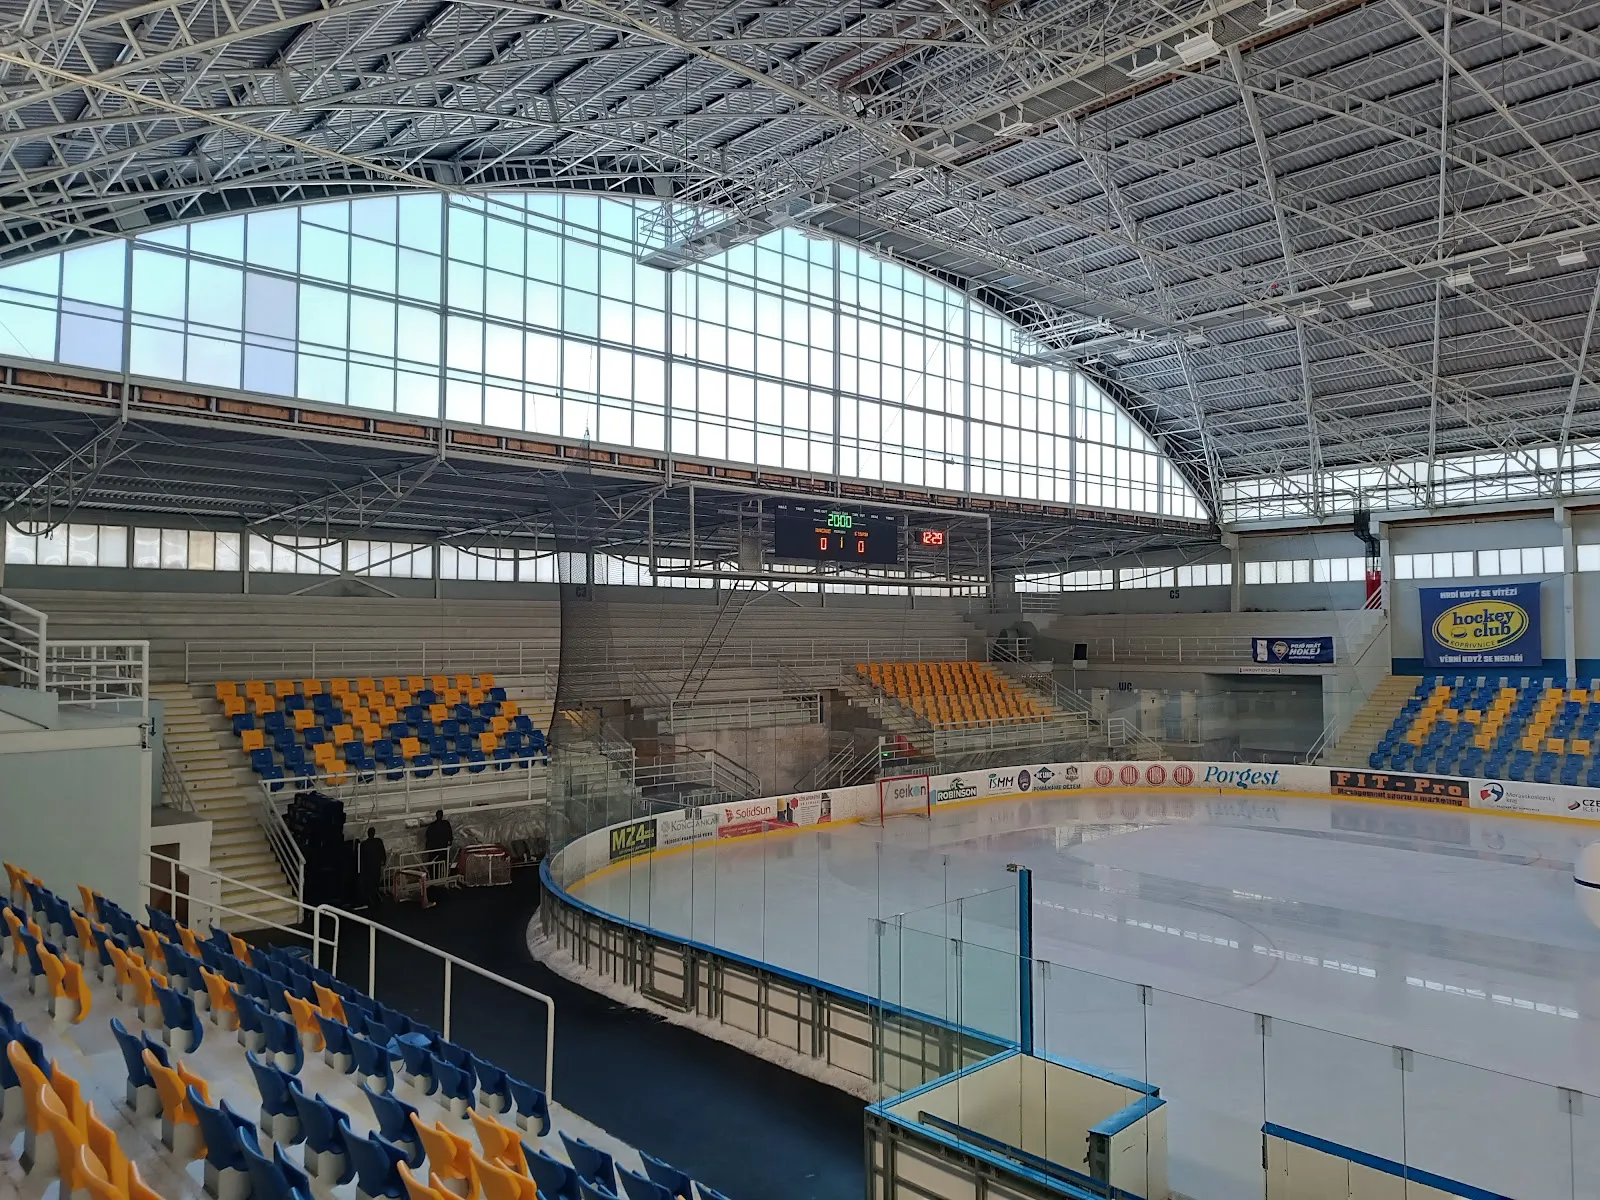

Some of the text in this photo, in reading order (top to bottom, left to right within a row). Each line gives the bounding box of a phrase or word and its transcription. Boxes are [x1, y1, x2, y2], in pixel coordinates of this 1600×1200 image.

[827, 513, 852, 528] 20:00
[820, 537, 827, 551] 0
[923, 531, 943, 545] 12:29
[857, 540, 865, 553] 0
[1169, 589, 1180, 599] C5
[1440, 590, 1459, 599] HRDÍ
[1459, 589, 1480, 598] KDYŽ
[1481, 589, 1491, 597] SE
[1452, 609, 1516, 626] hockey
[1473, 622, 1511, 638] club
[1462, 654, 1482, 663] KDYŽ
[1118, 682, 1132, 691] WC
[1204, 765, 1280, 789] Porgest
[894, 784, 927, 800] seikon
[937, 787, 976, 801] ROBINSON
[735, 805, 771, 819] SolidSun
